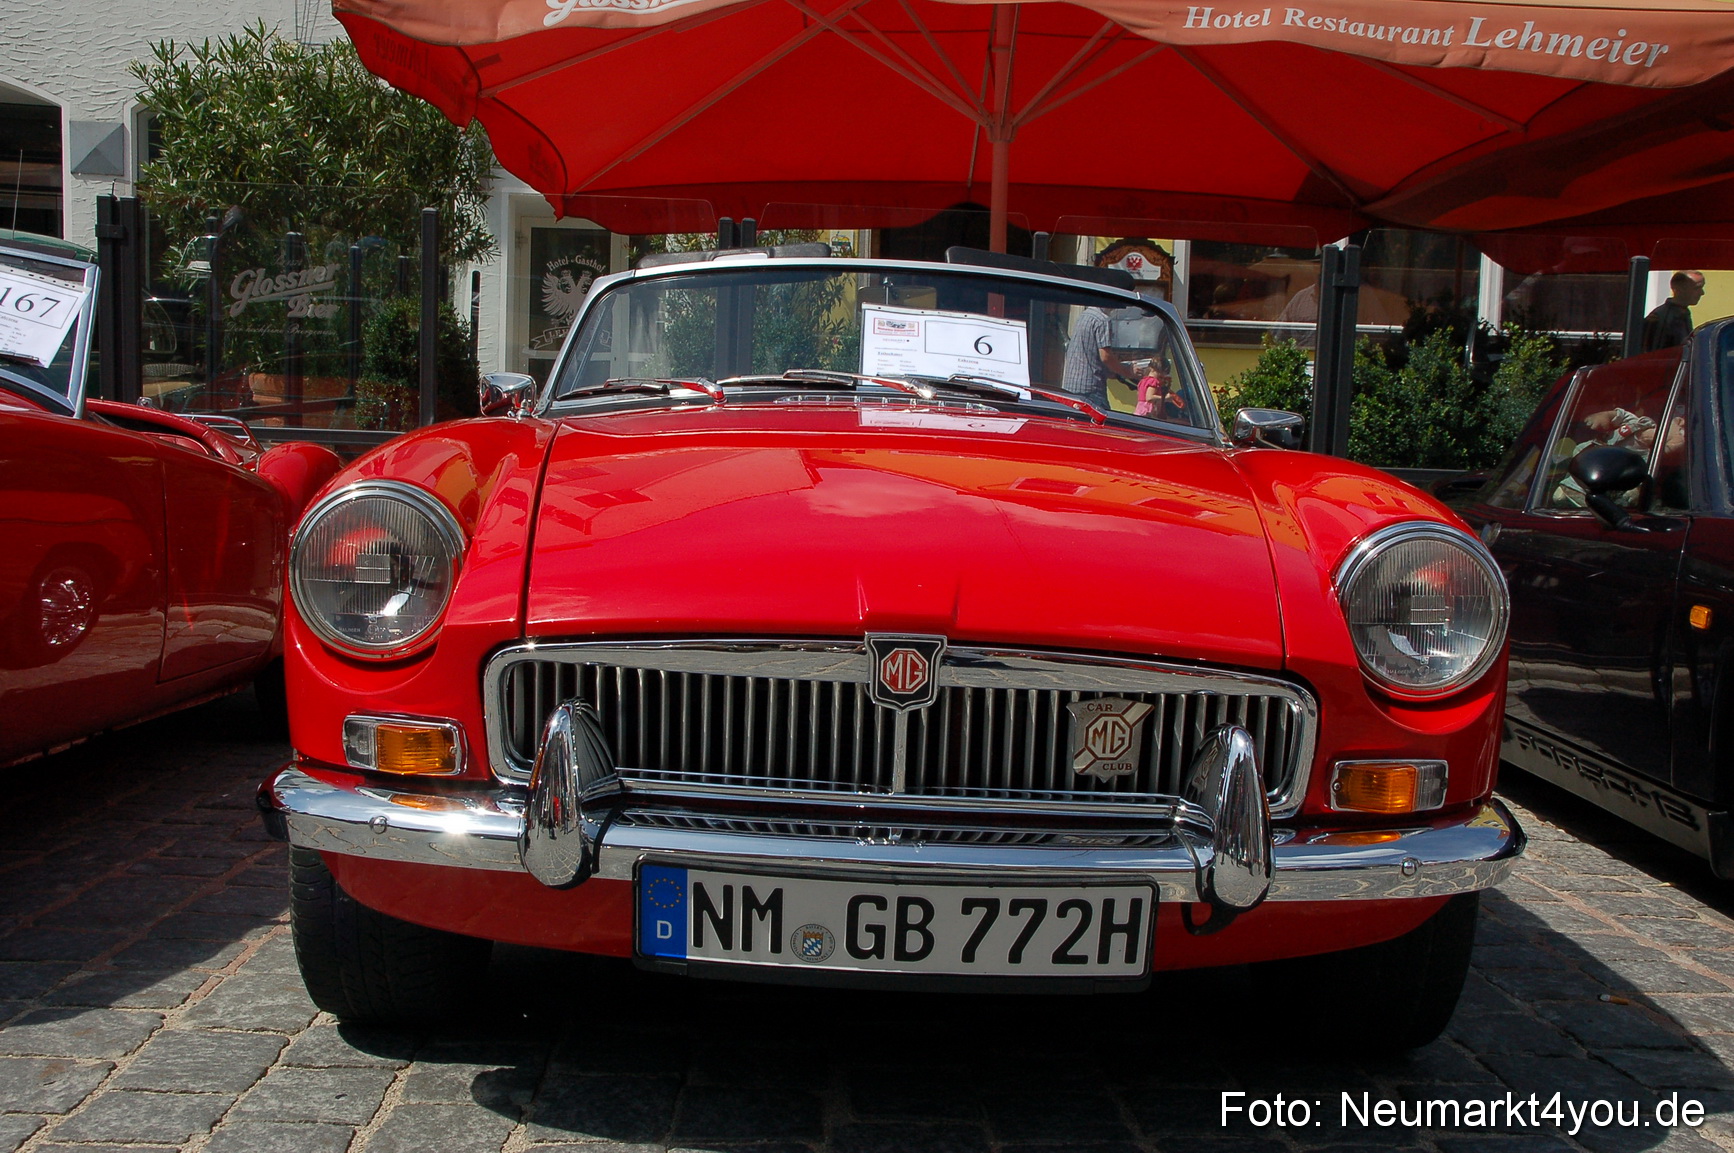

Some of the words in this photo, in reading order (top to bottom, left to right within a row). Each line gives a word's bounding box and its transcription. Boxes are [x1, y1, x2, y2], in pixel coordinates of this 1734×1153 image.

[1183, 5, 1271, 30] Hotel
[1281, 7, 1454, 47] Restaurant
[1461, 16, 1671, 69] Lehmeier
[546, 255, 569, 272] Hotel
[574, 254, 607, 272] Gasthof
[0, 286, 62, 319] 167
[229, 263, 341, 318] Glossner
[287, 293, 341, 319] Bier
[973, 335, 993, 356] 6
[886, 653, 923, 690] MG
[1086, 703, 1113, 712] CAR
[1091, 720, 1126, 755] MG
[1102, 762, 1133, 771] CLUB
[1513, 727, 1700, 832] PORSCHE
[656, 920, 673, 939] D
[692, 881, 784, 954] NM
[845, 894, 935, 962] GB
[960, 897, 1143, 966] 772H
